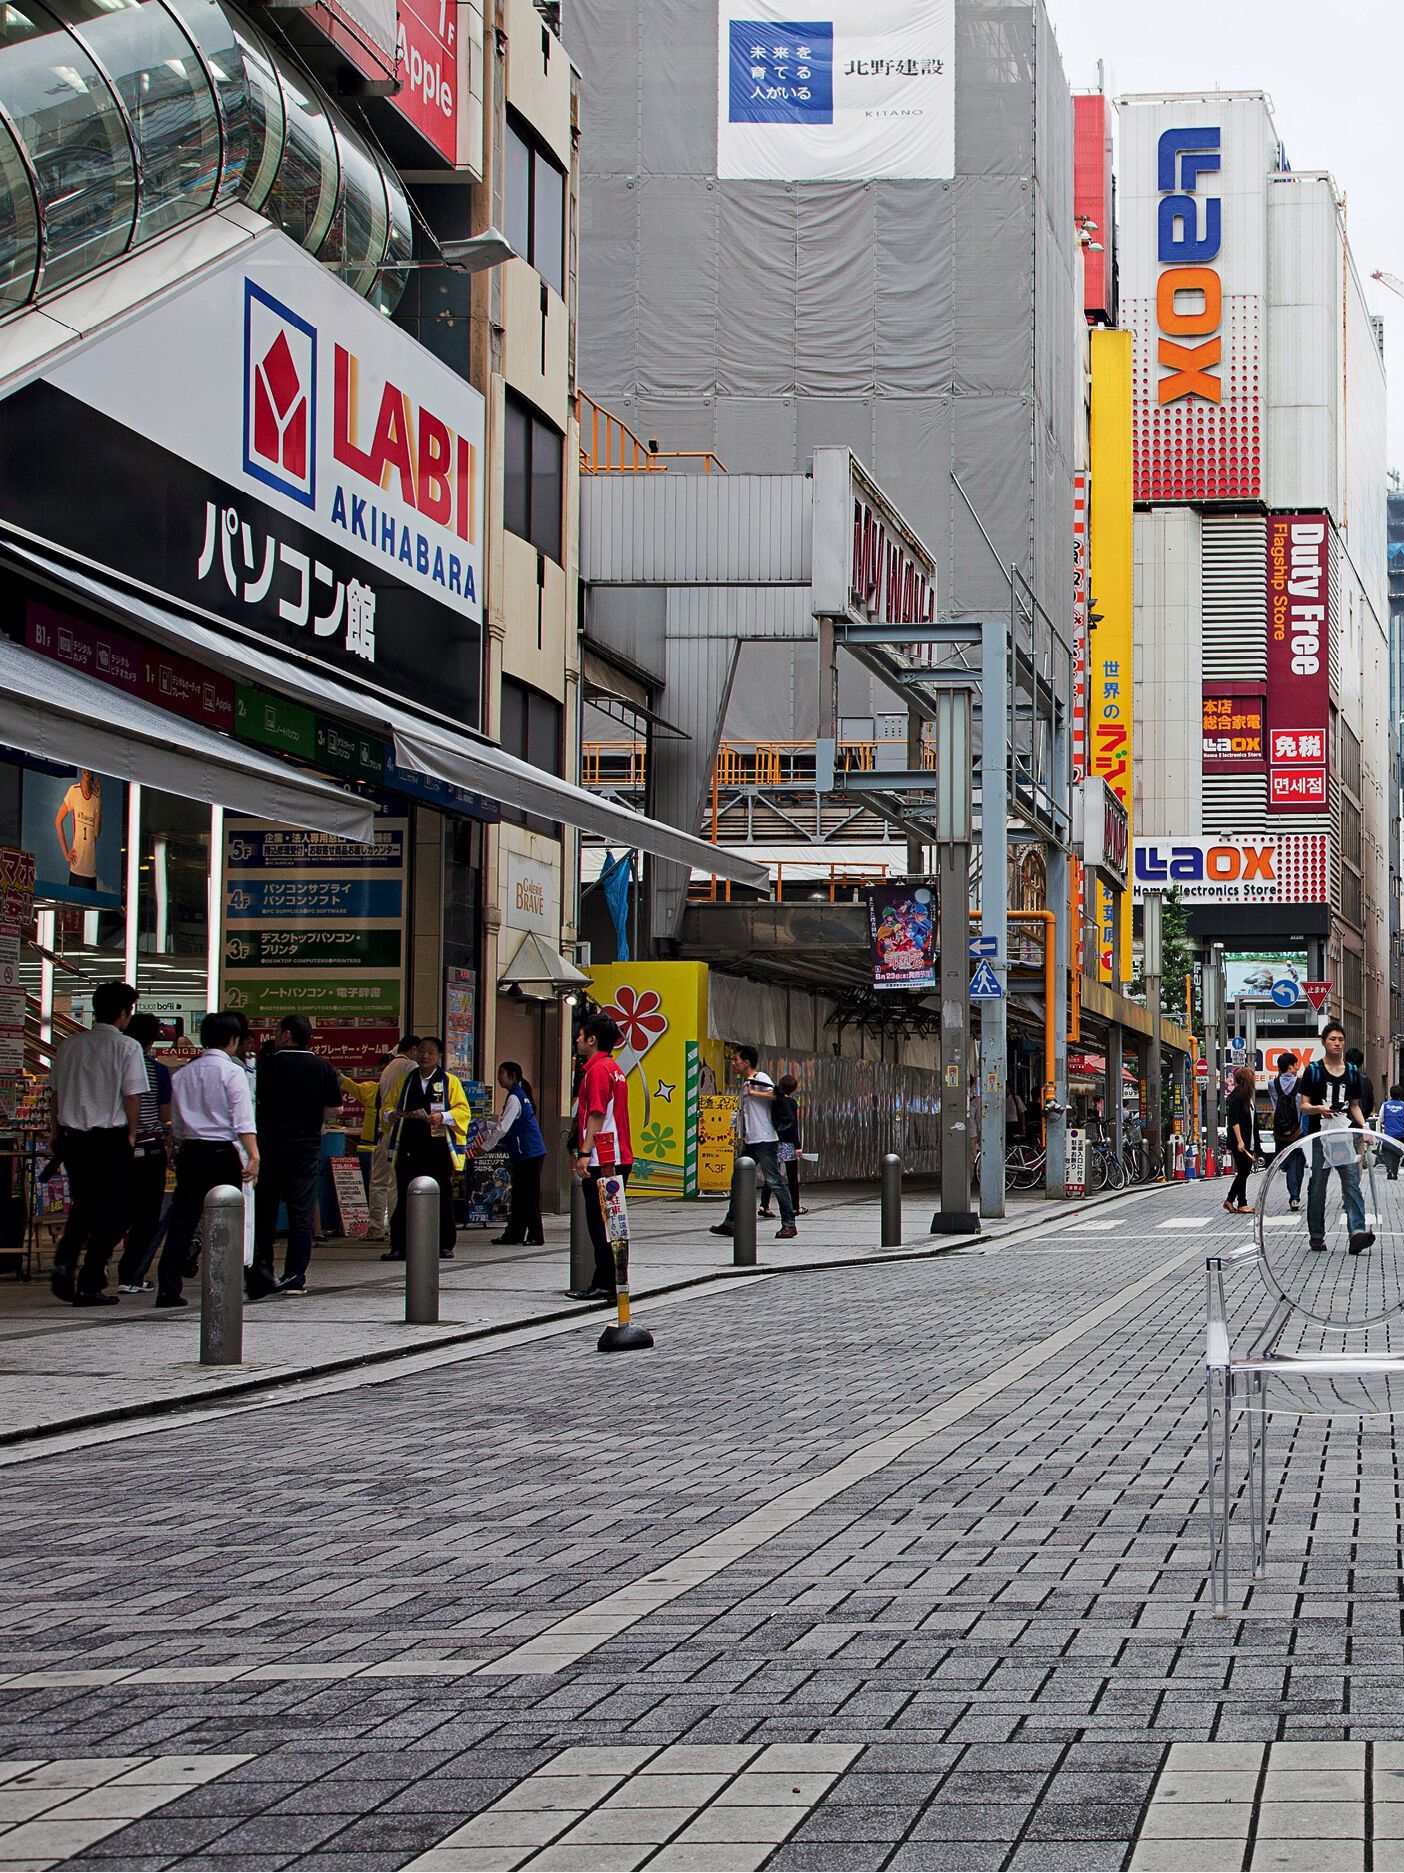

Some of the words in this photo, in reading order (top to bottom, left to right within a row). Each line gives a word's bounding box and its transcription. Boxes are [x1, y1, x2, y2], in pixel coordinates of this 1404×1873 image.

[750, 46, 811, 59] 未来を
[398, 22, 453, 117] Apple
[750, 66, 811, 79] 育てる
[844, 59, 944, 76] 北野建設
[750, 86, 811, 100] 人がいる
[865, 109, 924, 117] KITANO
[333, 341, 477, 545] LABI
[330, 485, 478, 604] AKIHABARA
[1270, 523, 1288, 590] Flagship
[1287, 524, 1325, 597] Duty
[198, 501, 376, 662] パソコン館
[1273, 595, 1288, 640] Store
[1290, 605, 1325, 675] Free
[1103, 661, 1121, 719] 世界の
[1203, 700, 1232, 713] 本店
[1203, 715, 1261, 730] 総合家電
[1275, 735, 1322, 758] 免税
[1274, 777, 1323, 795] 면세점
[230, 840, 250, 861] 5F
[263, 884, 352, 894] パソコンサプライ
[1176, 885, 1240, 896] Electronics
[1244, 884, 1277, 896] Store
[229, 889, 250, 910] 4F
[263, 895, 341, 906] パソコンソフト
[229, 938, 250, 960] 3F
[261, 945, 298, 955] プリンタ
[260, 987, 381, 998] ノートパソコン・電子辞書
[1307, 986, 1327, 994] 止まれ
[714, 1164, 726, 1174] 3F
